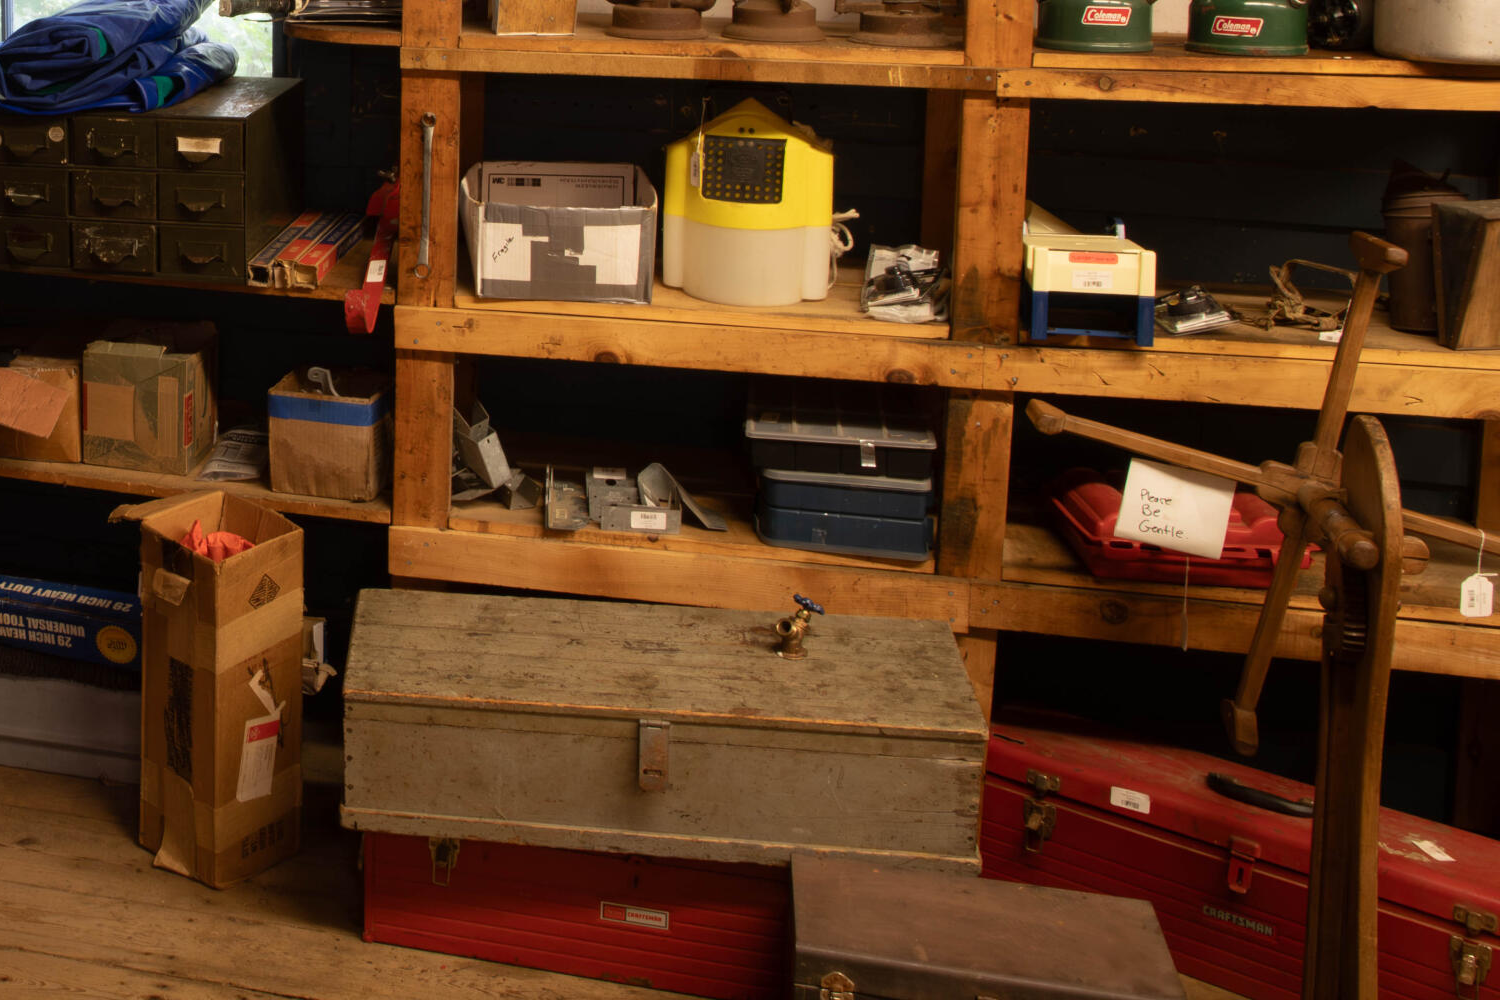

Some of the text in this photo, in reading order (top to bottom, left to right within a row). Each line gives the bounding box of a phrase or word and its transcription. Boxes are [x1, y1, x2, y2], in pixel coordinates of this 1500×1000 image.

[1087, 9, 1122, 21] Coleman
[1216, 19, 1251, 32] Coleman
[1141, 488, 1172, 505] Please
[1142, 504, 1161, 517] Be
[32, 588, 77, 603] HEAVY
[77, 595, 111, 609] INCH
[112, 601, 133, 613] 29
[0, 612, 24, 627] TOOL
[26, 616, 86, 638] UNIVERSAL
[28, 630, 56, 644] INCH
[58, 635, 72, 648] 29
[1203, 905, 1273, 936] CRAFTSMAN
